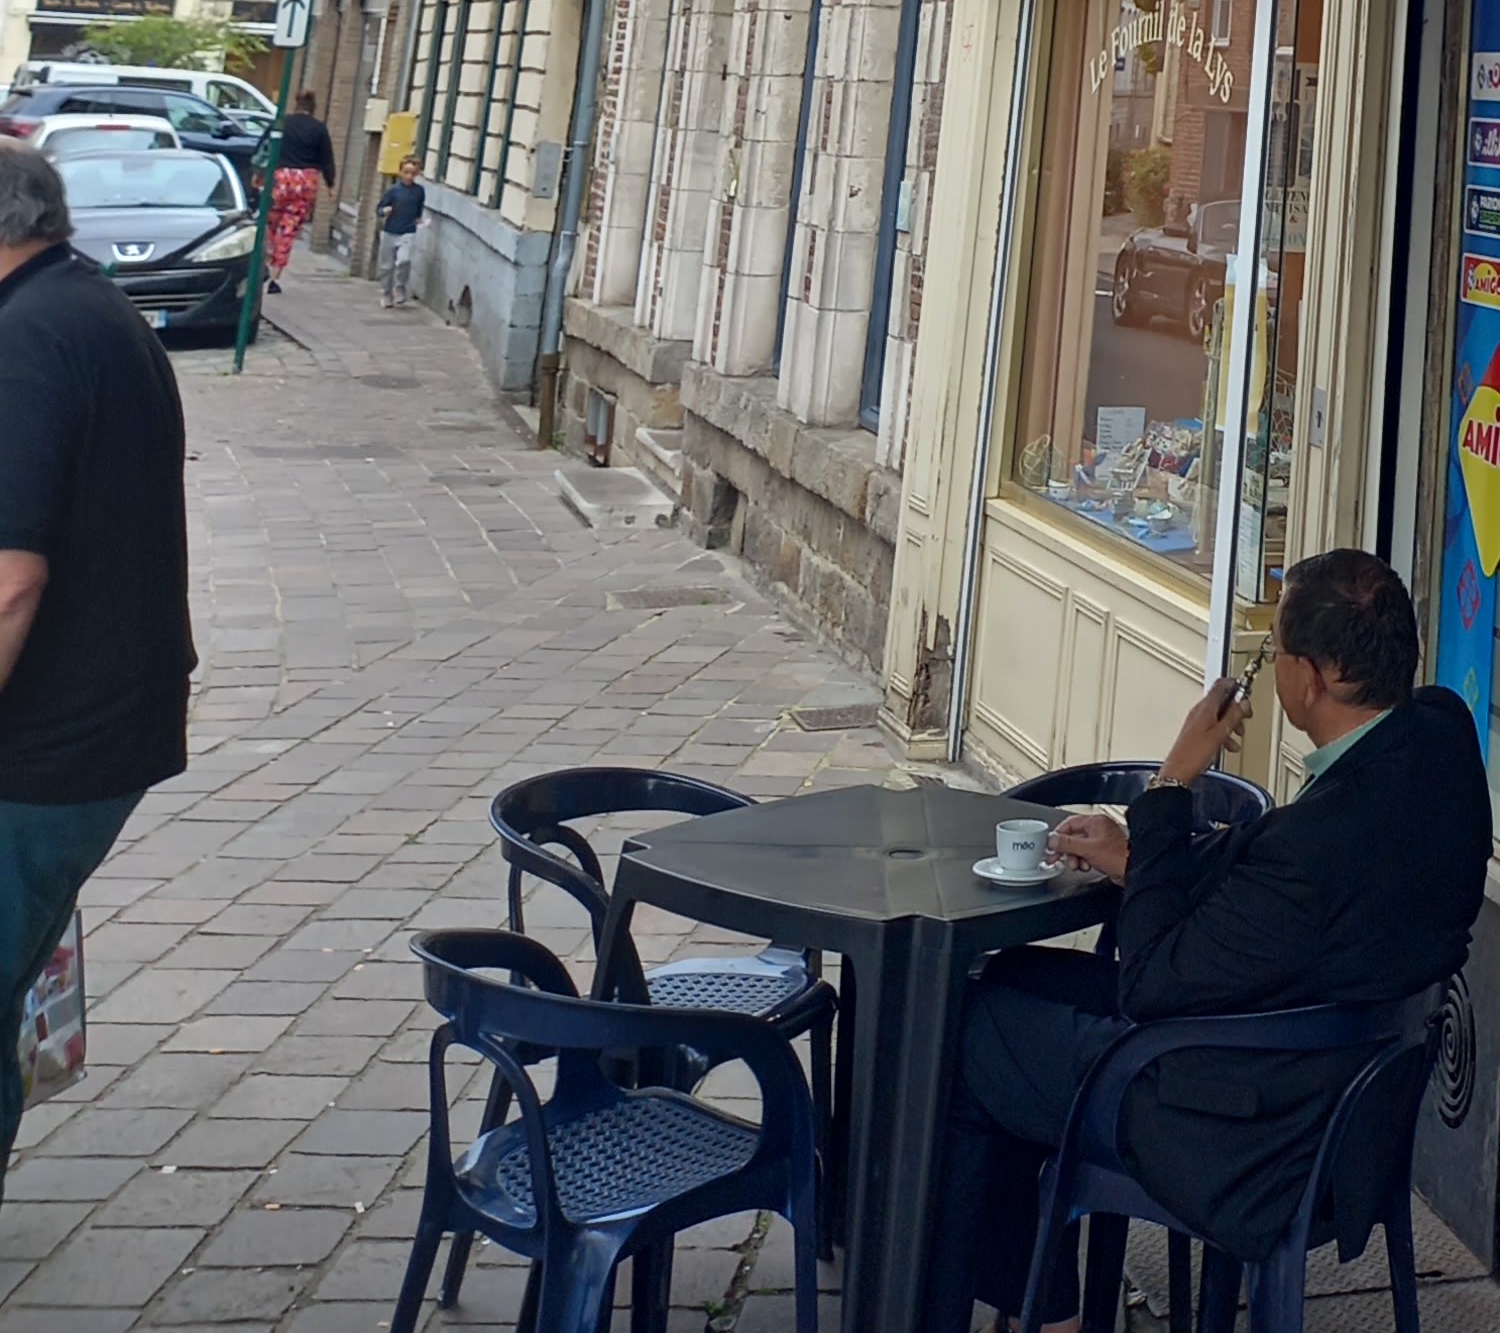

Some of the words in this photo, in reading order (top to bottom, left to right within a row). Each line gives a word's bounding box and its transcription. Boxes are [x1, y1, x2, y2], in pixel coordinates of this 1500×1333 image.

[1089, 49, 1107, 94] Le
[1111, 0, 1165, 67] Fournil
[1167, 2, 1186, 48] de
[1187, 11, 1205, 62] la
[1204, 34, 1234, 104] Lys
